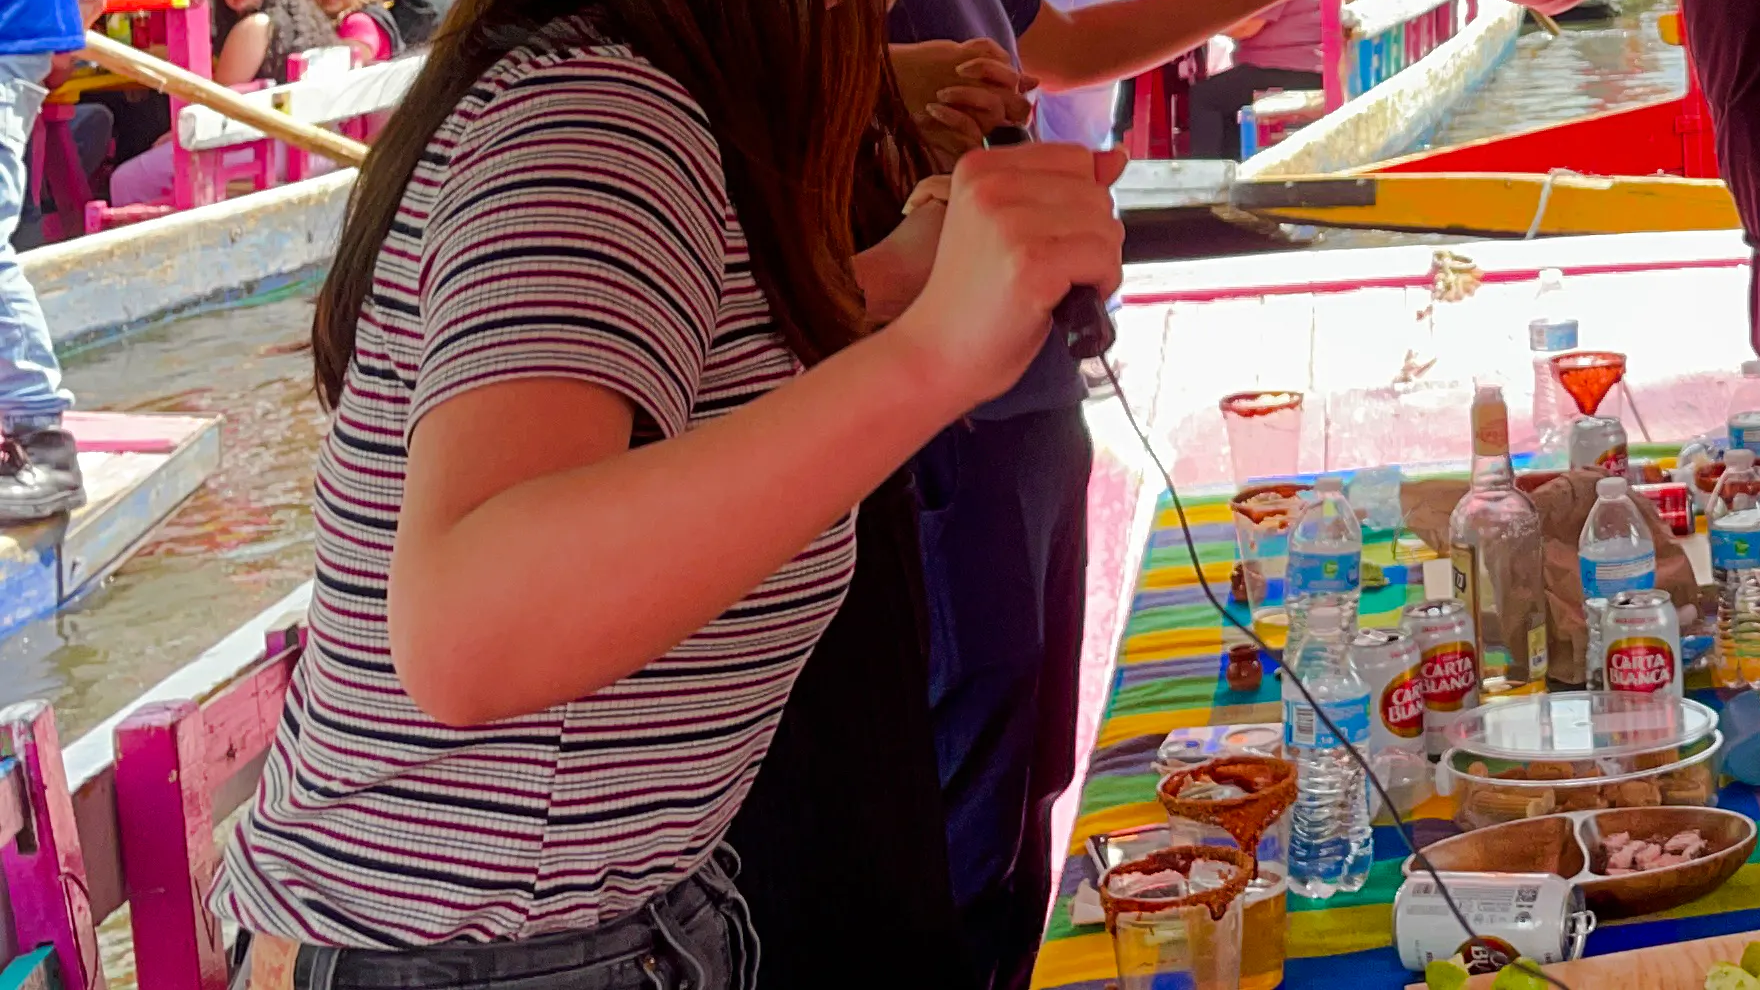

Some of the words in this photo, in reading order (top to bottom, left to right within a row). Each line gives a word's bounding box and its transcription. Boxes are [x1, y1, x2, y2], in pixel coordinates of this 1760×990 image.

[1421, 656, 1473, 679] CARTA
[1611, 653, 1666, 671] CARTA
[1609, 667, 1670, 686] BLANCA
